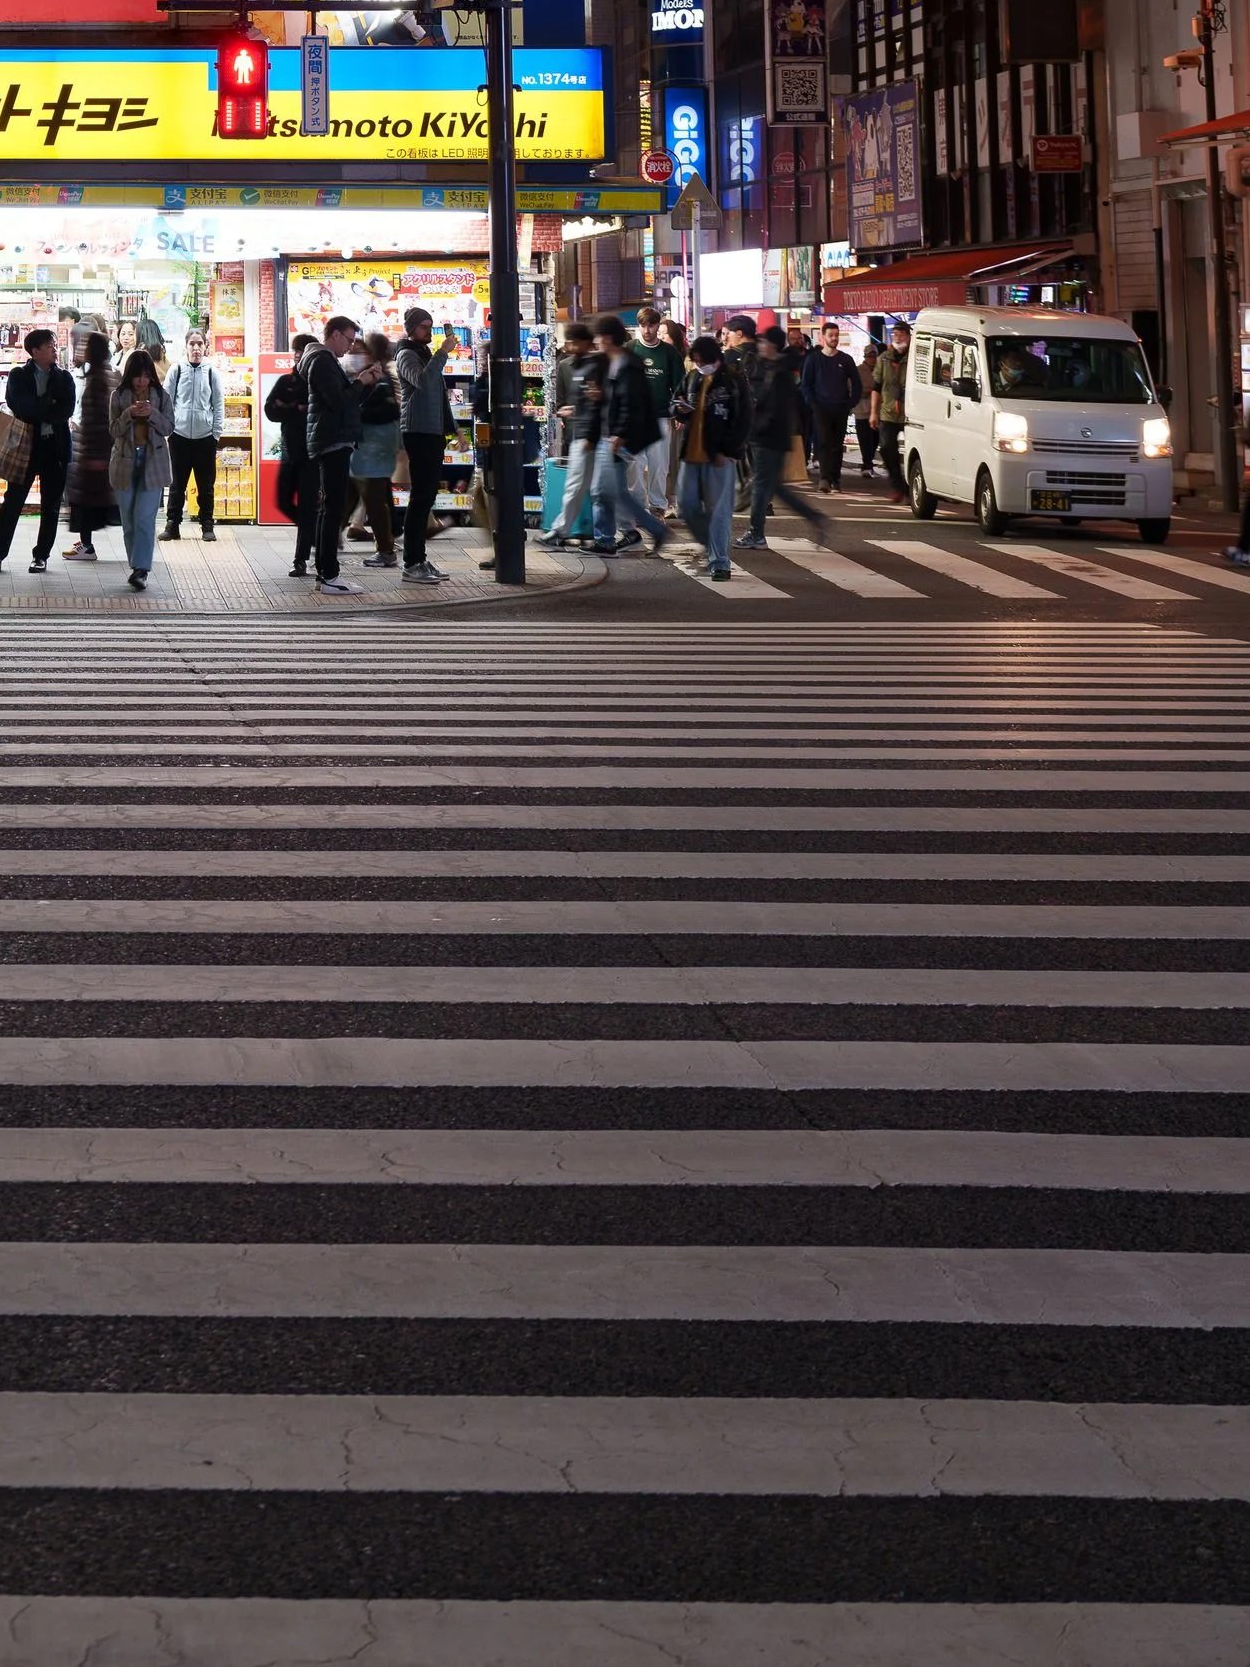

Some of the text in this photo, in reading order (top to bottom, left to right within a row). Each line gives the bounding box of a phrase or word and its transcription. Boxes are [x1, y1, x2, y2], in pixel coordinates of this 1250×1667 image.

[308, 45, 323, 127] 夜間 押ボタン式
[211, 112, 548, 138] tsmoto KiYohi
[386, 148, 438, 159] この看板は
[442, 149, 464, 159] LED
[647, 160, 672, 174] 消火栓
[190, 188, 226, 199] 支付宝
[264, 190, 299, 198] 微信支付
[448, 191, 485, 202] 支付宝
[519, 192, 554, 201] 微信支付
[156, 233, 215, 254] SALE
[302, 267, 315, 275] GP
[403, 273, 476, 286] アクリルスタンド
[843, 287, 939, 310] TOKYO RADIO DEPARTMENT STORE
